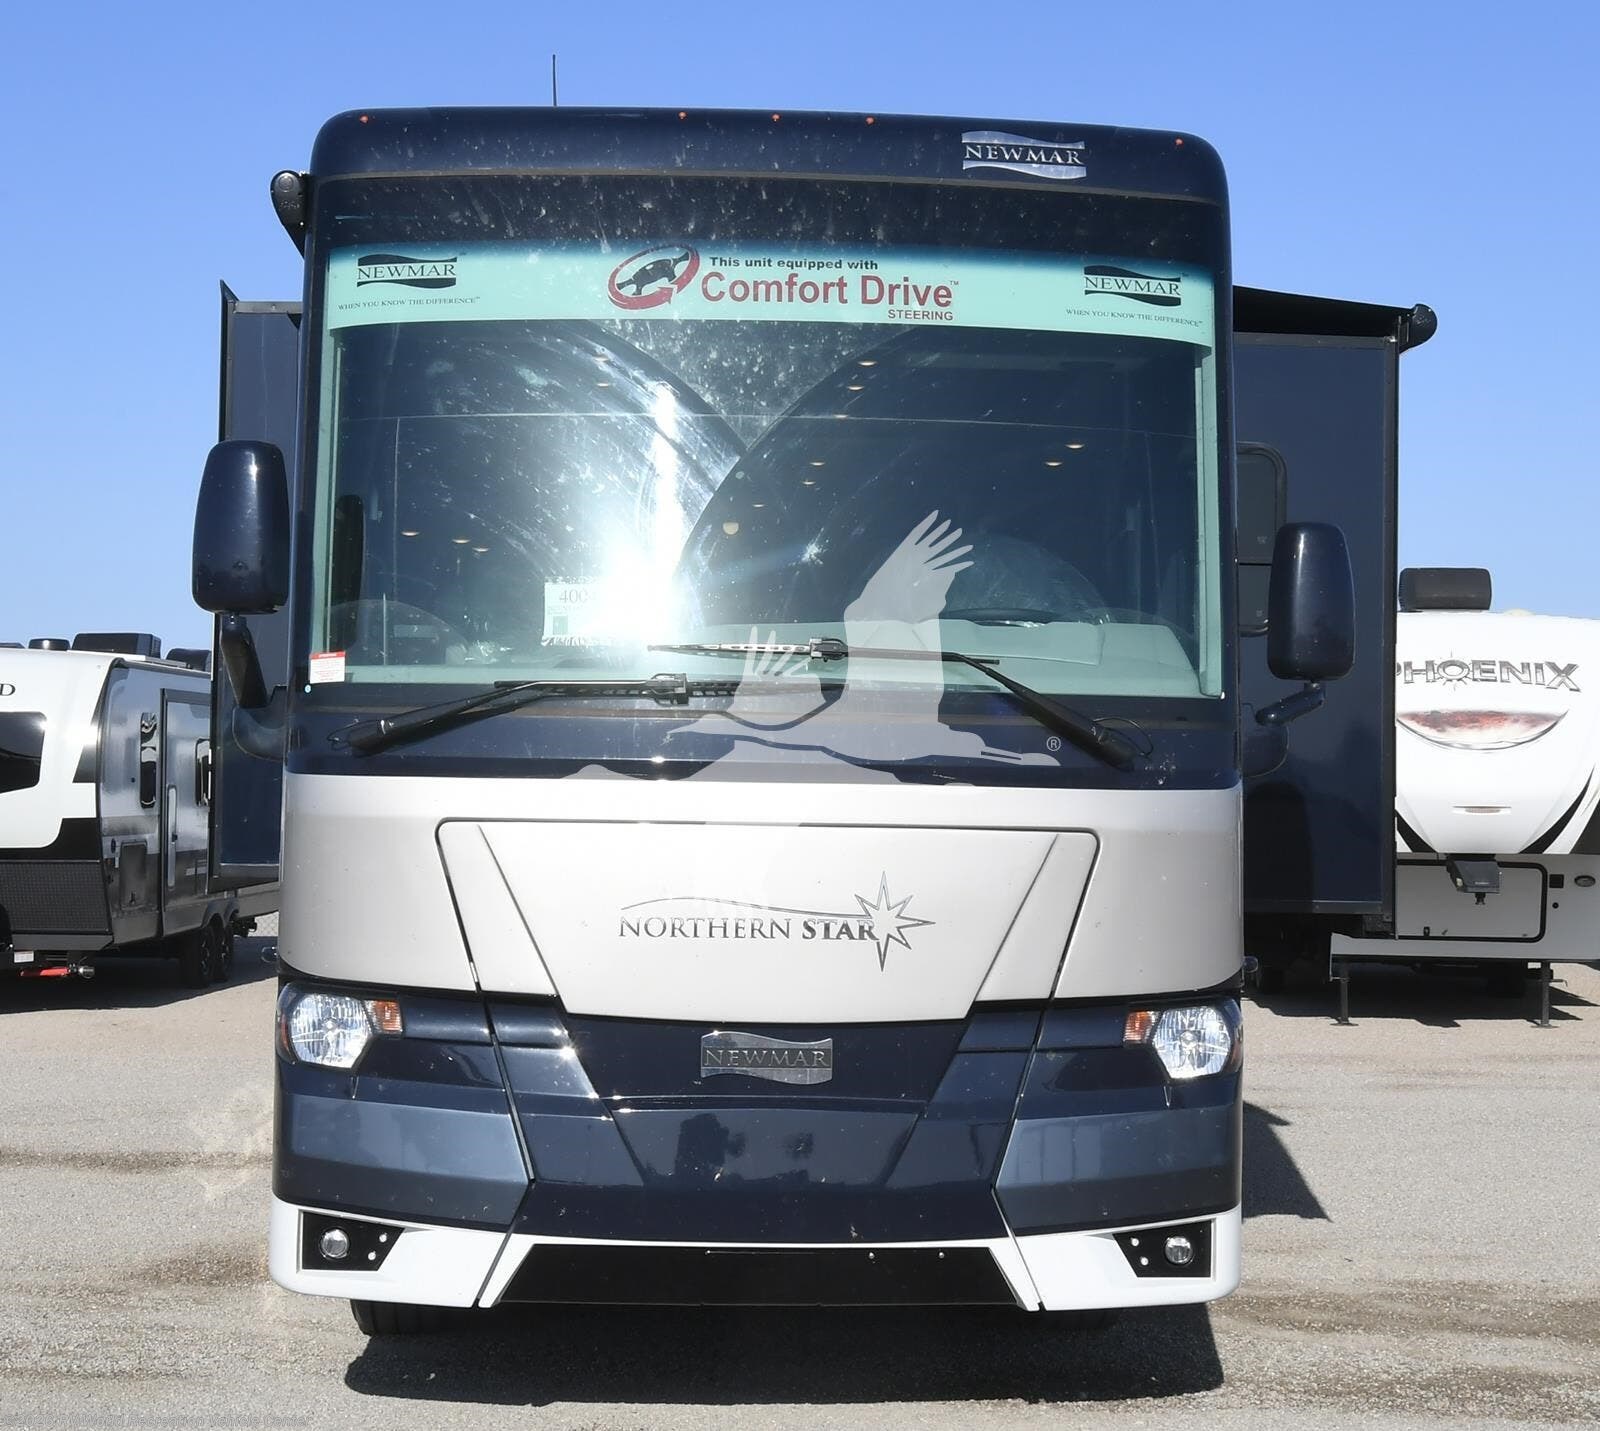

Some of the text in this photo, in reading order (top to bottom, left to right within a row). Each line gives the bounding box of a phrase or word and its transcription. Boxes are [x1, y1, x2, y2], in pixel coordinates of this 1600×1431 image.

[964, 144, 1084, 165] NEWMAR
[358, 263, 456, 280] NEWMAR
[710, 256, 879, 271] This unit equipped with
[701, 271, 848, 303] Comfort
[861, 275, 953, 308] Drive
[1084, 276, 1181, 296] NEWMAR
[337, 301, 361, 311] WHEN
[362, 300, 380, 308] YOU
[381, 299, 407, 307] KNOW
[425, 296, 476, 305] DIFFERENCE
[887, 308, 954, 321] STEERING
[1065, 308, 1091, 316] WHEN
[1110, 311, 1137, 319] KNOW
[1137, 313, 1153, 321] THE
[1153, 314, 1200, 328] DIFFERENCE
[618, 916, 880, 941] NORTHERN STAR
[703, 1048, 831, 1068] NEWMAR
